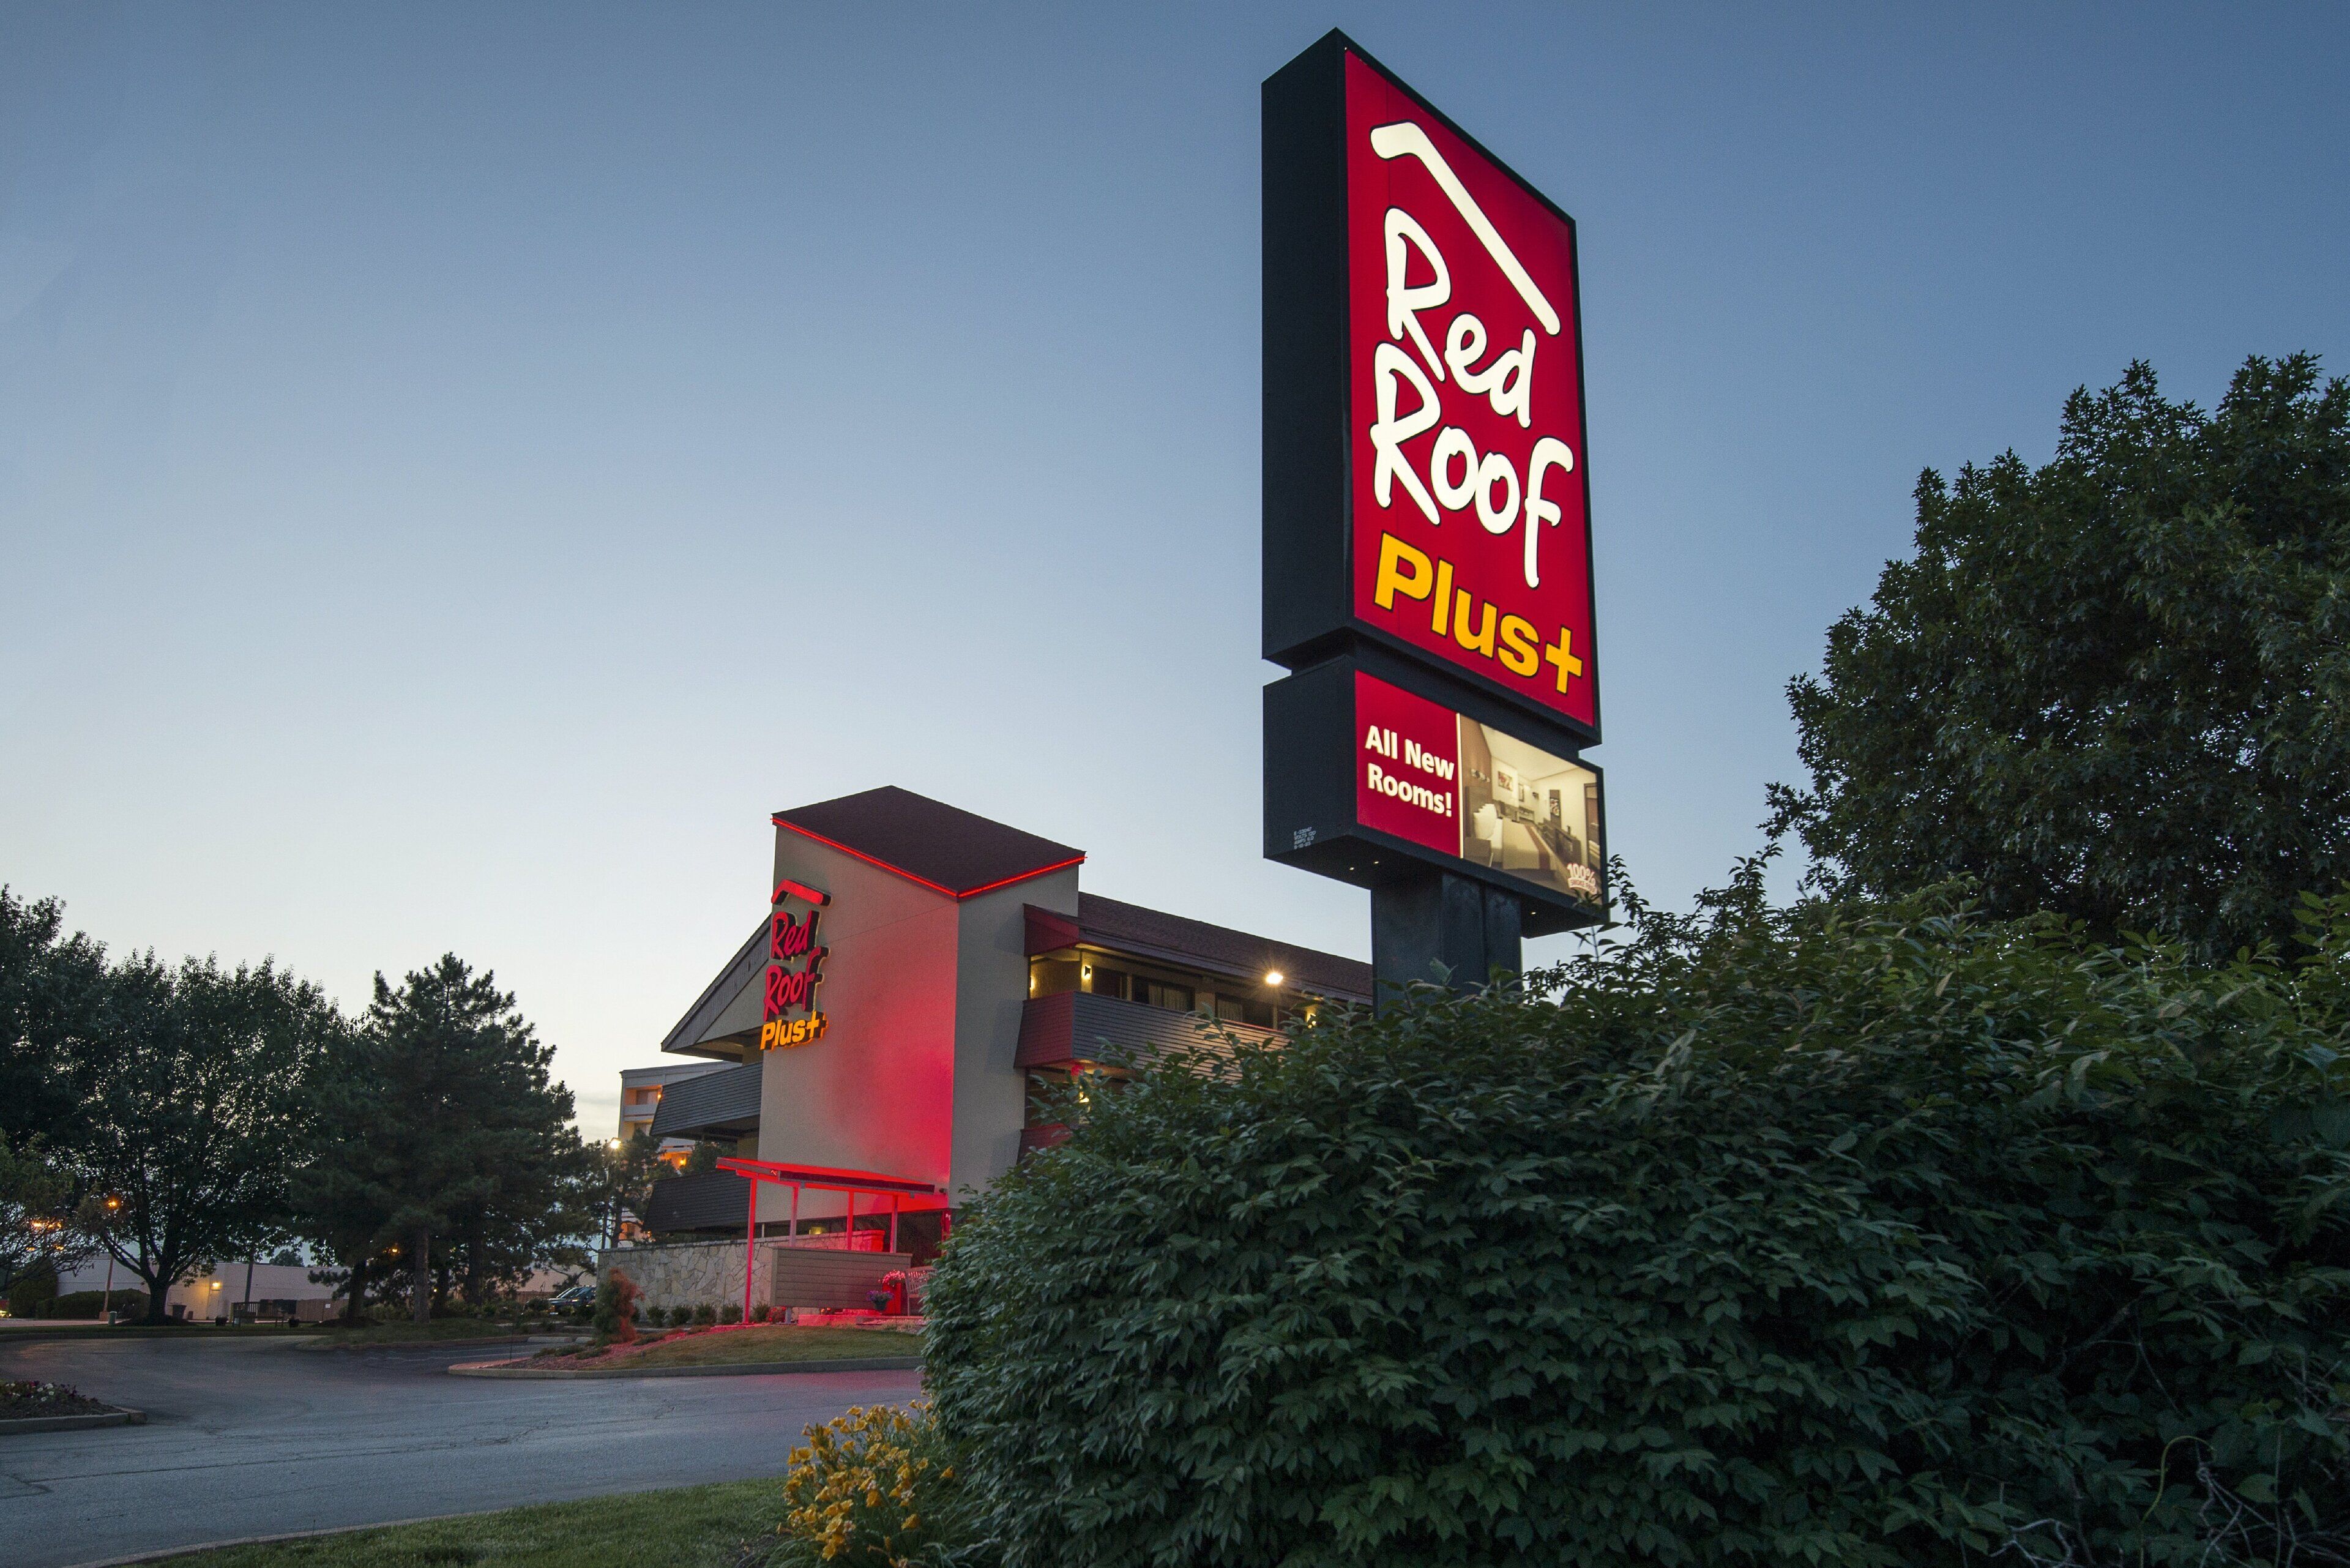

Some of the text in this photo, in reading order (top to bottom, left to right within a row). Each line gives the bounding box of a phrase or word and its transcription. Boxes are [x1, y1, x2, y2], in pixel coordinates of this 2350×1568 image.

[1384, 207, 1537, 428] Red
[1369, 342, 1574, 589] Roof
[1373, 532, 1583, 694] Plus+
[1365, 725, 1455, 781] All New
[1367, 763, 1452, 818] Rooms!
[1567, 863, 1596, 887] 100%
[770, 909, 814, 960] Red
[763, 946, 822, 1022] Roof
[760, 1010, 820, 1051] Plus+
